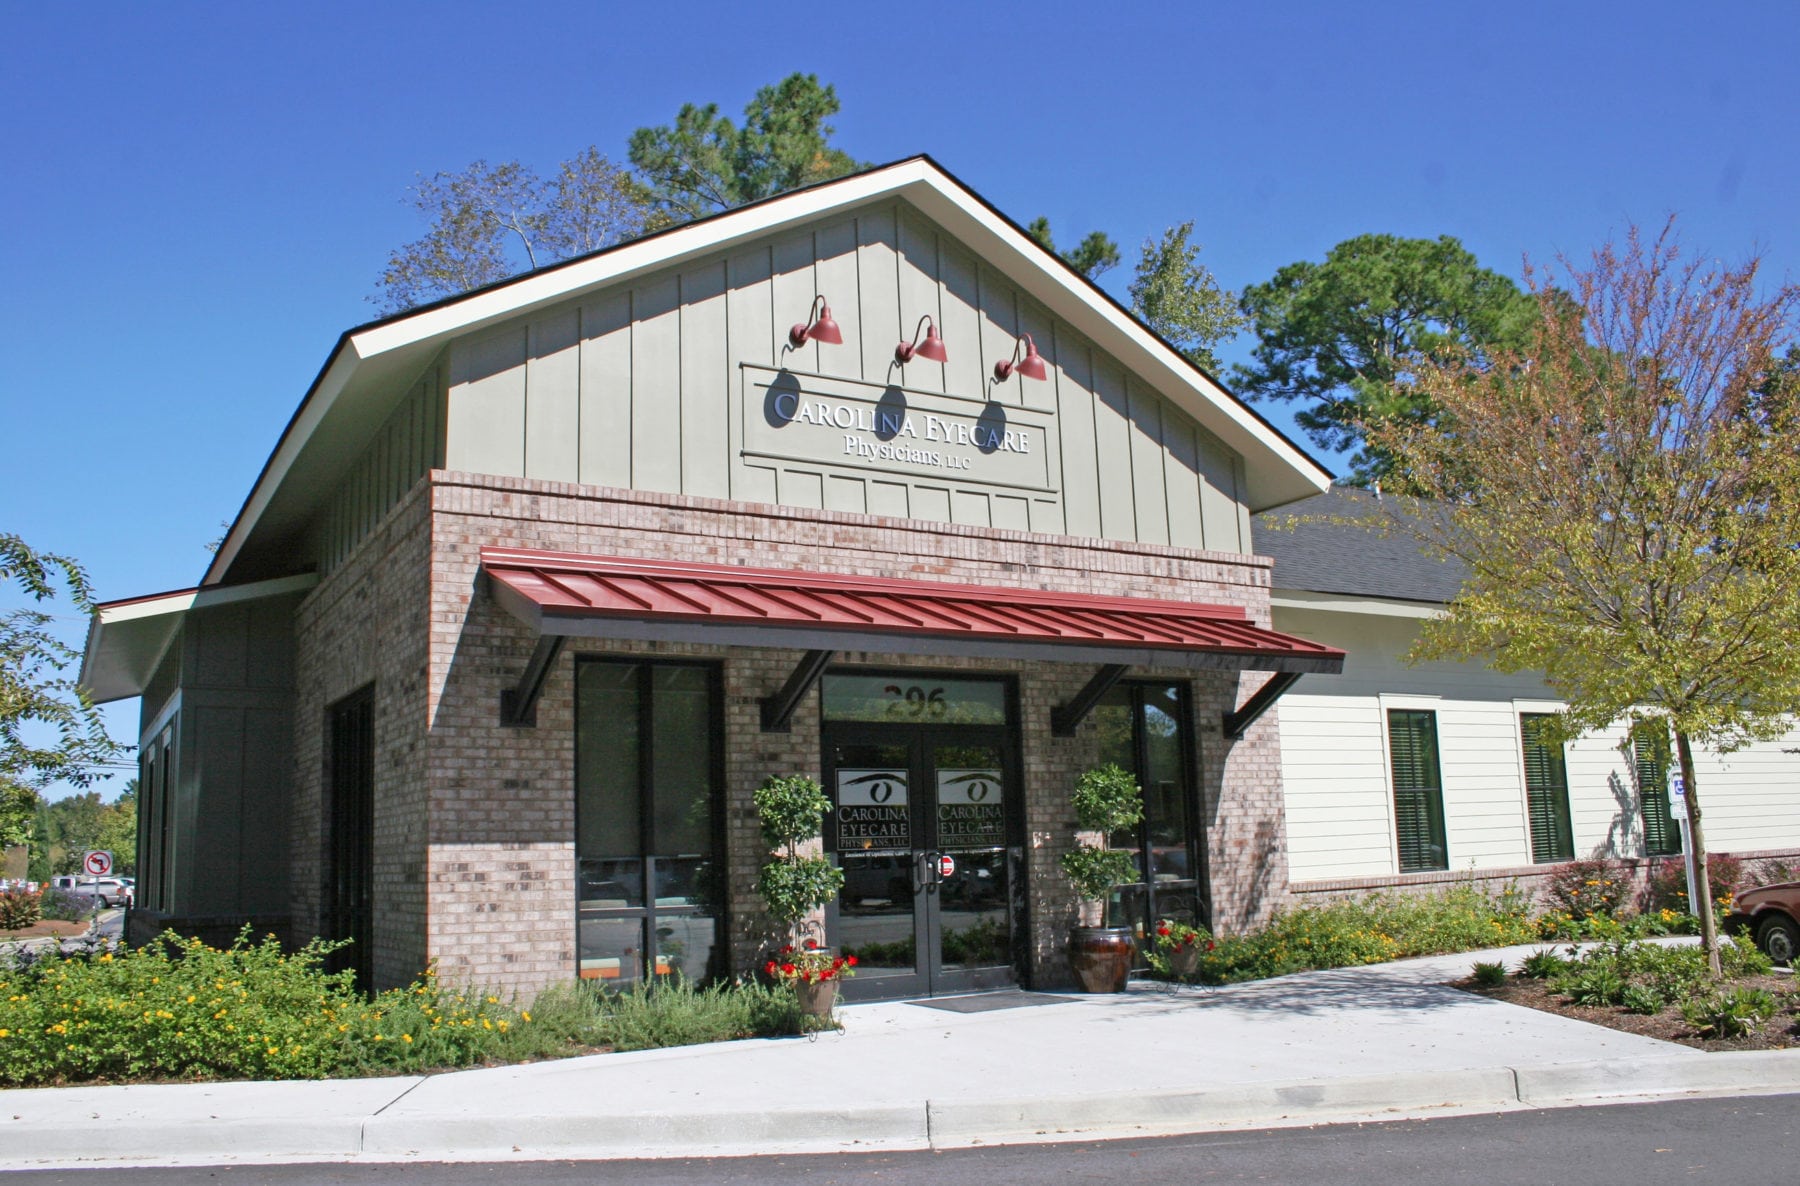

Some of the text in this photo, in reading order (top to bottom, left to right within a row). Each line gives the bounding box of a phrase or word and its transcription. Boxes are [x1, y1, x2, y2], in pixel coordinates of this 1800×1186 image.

[774, 393, 1031, 454] CAROLINA EYECARE
[844, 434, 971, 470] Physicians, LLC
[884, 685, 947, 718] 296
[838, 806, 909, 823] CAROLINA
[938, 805, 1003, 821] CAROLINA
[841, 823, 907, 837] EYECARE
[941, 822, 1003, 834] EYECARE
[841, 838, 909, 848] PHYSIANS, LLC
